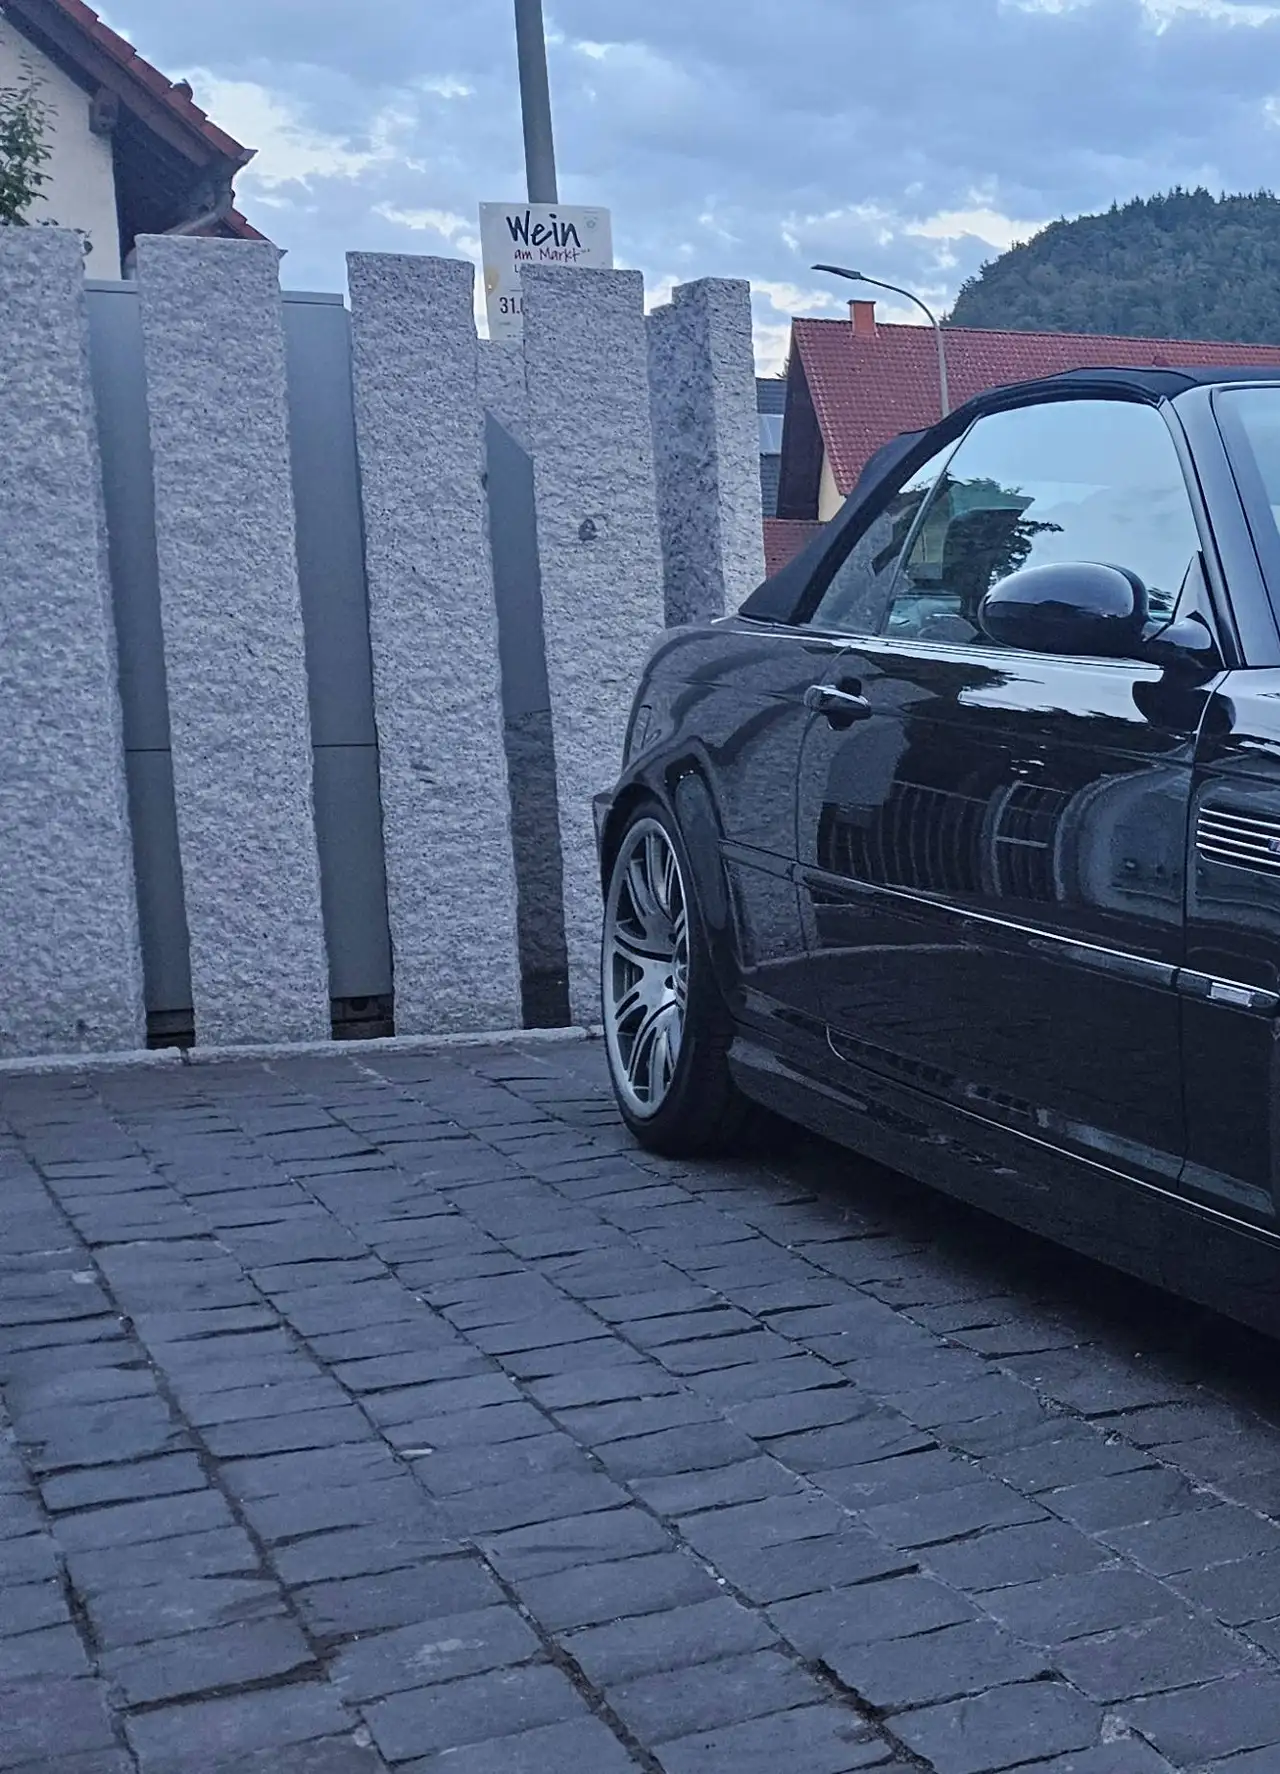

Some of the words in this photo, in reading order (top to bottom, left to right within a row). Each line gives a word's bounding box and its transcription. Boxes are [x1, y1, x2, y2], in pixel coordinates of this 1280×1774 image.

[506, 210, 581, 248] Wein
[514, 248, 532, 260] am
[539, 247, 580, 262] Markt
